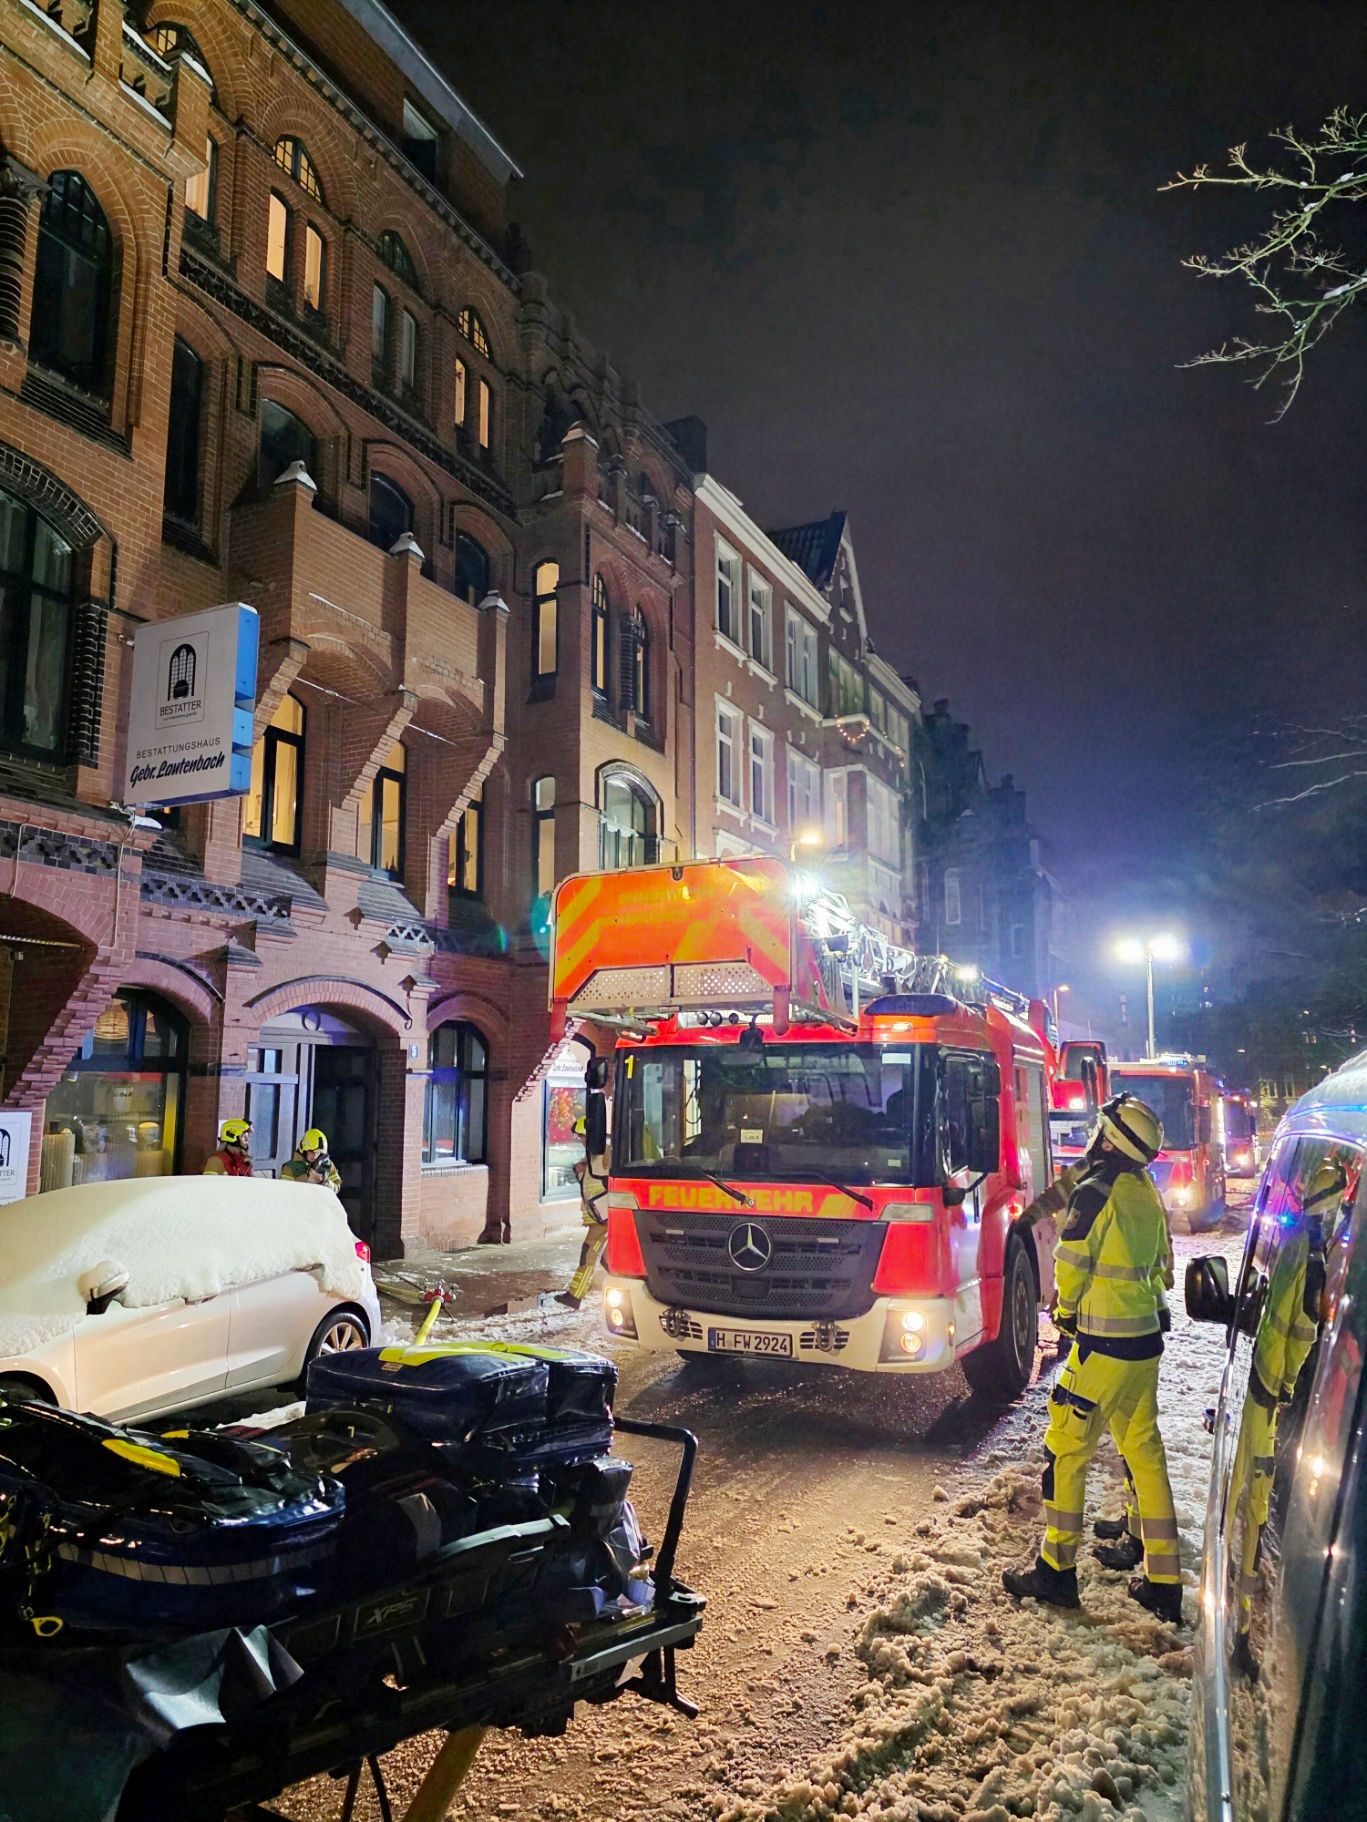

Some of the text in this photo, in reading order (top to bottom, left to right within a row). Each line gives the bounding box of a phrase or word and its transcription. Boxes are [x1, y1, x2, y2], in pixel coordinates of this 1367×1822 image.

[159, 700, 202, 716] BESTATTER
[136, 736, 221, 760] BESTATTUNGSHAUS
[130, 752, 225, 789] Gebr. Lautenbach
[624, 1054, 634, 1079] 1
[716, 1332, 788, 1353] H FW 2924
